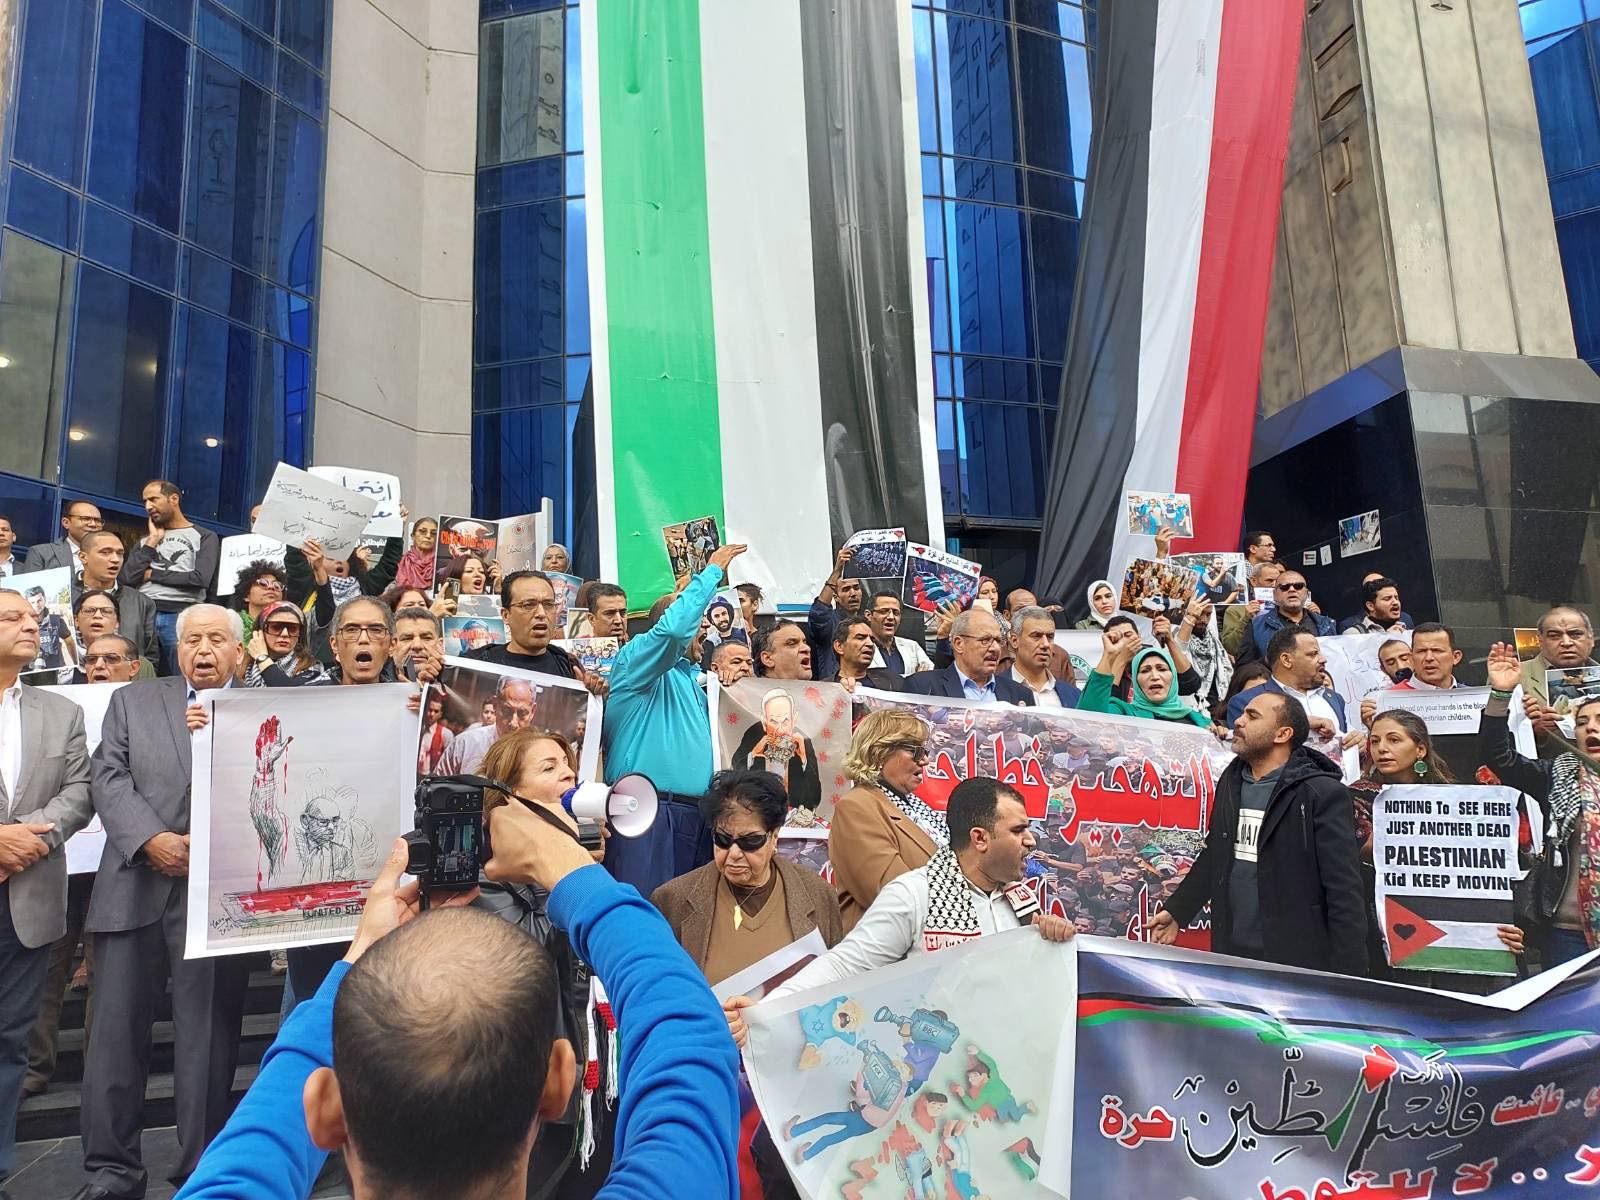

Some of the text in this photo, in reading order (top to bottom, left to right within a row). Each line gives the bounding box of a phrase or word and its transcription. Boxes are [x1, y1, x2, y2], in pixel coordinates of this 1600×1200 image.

[993, 731, 1054, 821] خط
[1384, 800, 1432, 815] NOTHING
[1458, 801, 1479, 816] SEE
[1483, 801, 1512, 817] HERE
[1386, 821, 1511, 838] JUST ANOTHER DEAD
[1384, 845, 1506, 870] PALESTINIAN
[1384, 872, 1513, 891] Kid KEEP MOVIN
[1100, 1094, 1177, 1150] حرة
[1452, 1156, 1499, 1196] لا
